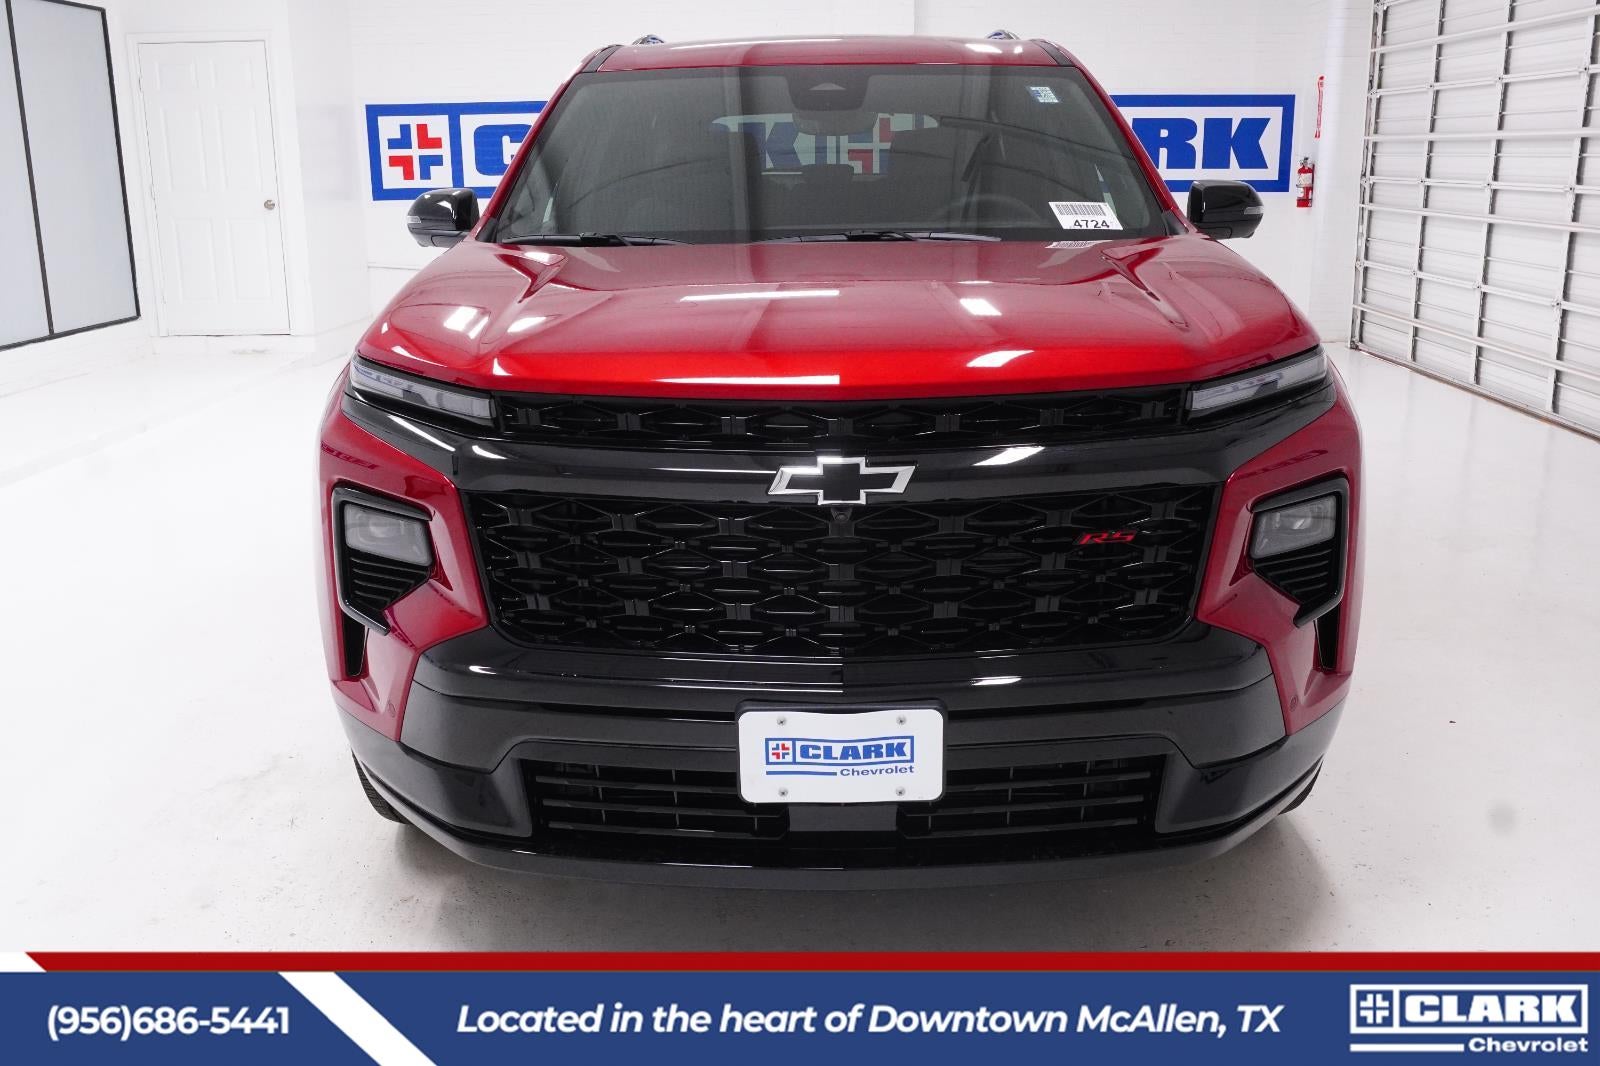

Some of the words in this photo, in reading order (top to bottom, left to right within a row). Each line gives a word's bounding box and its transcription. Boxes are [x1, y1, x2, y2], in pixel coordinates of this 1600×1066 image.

[1073, 219, 1110, 229] 4724
[1079, 529, 1137, 545] RS
[799, 742, 907, 760] CLARK
[839, 765, 914, 777] Chevrolet
